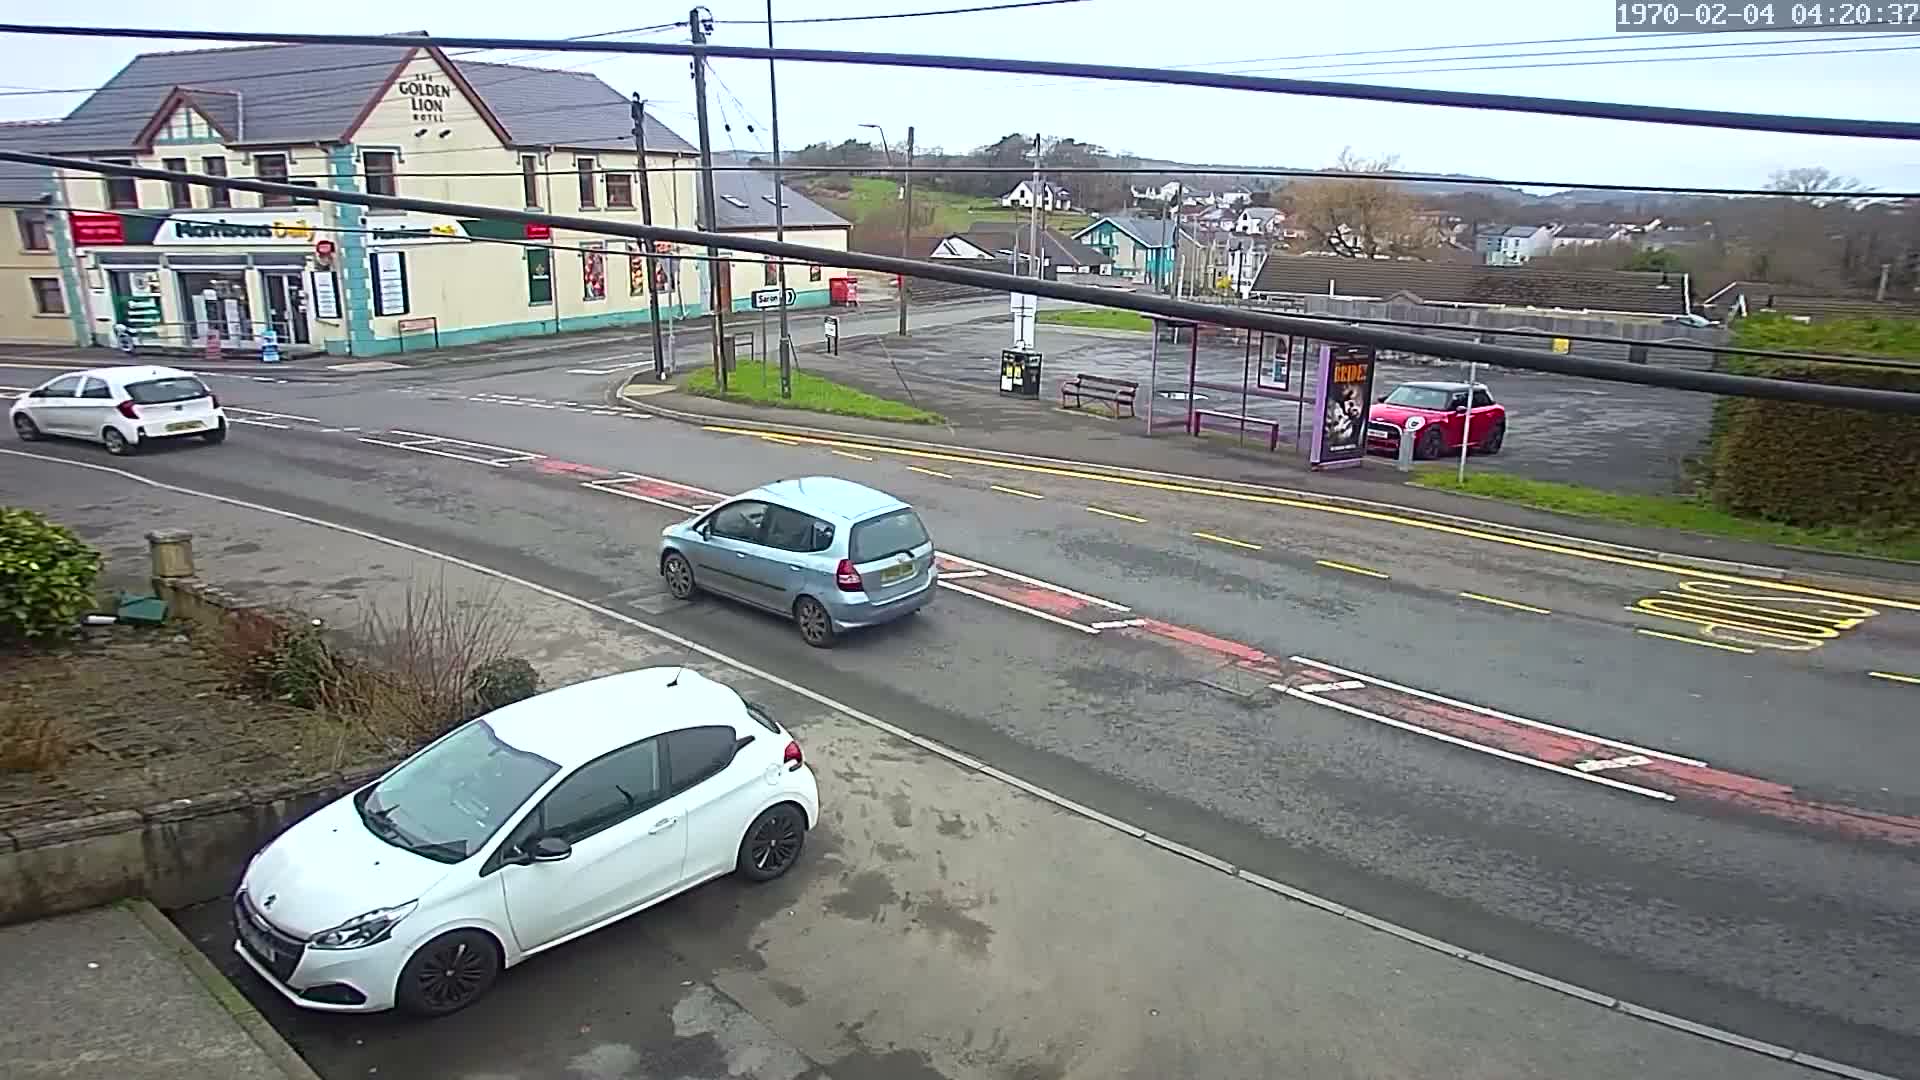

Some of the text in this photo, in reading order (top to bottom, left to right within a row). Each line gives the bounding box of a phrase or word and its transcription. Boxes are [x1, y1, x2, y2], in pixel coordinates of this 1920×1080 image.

[399, 81, 450, 98] GOLDEN
[411, 97, 443, 112] LION
[758, 294, 778, 304] Saron
